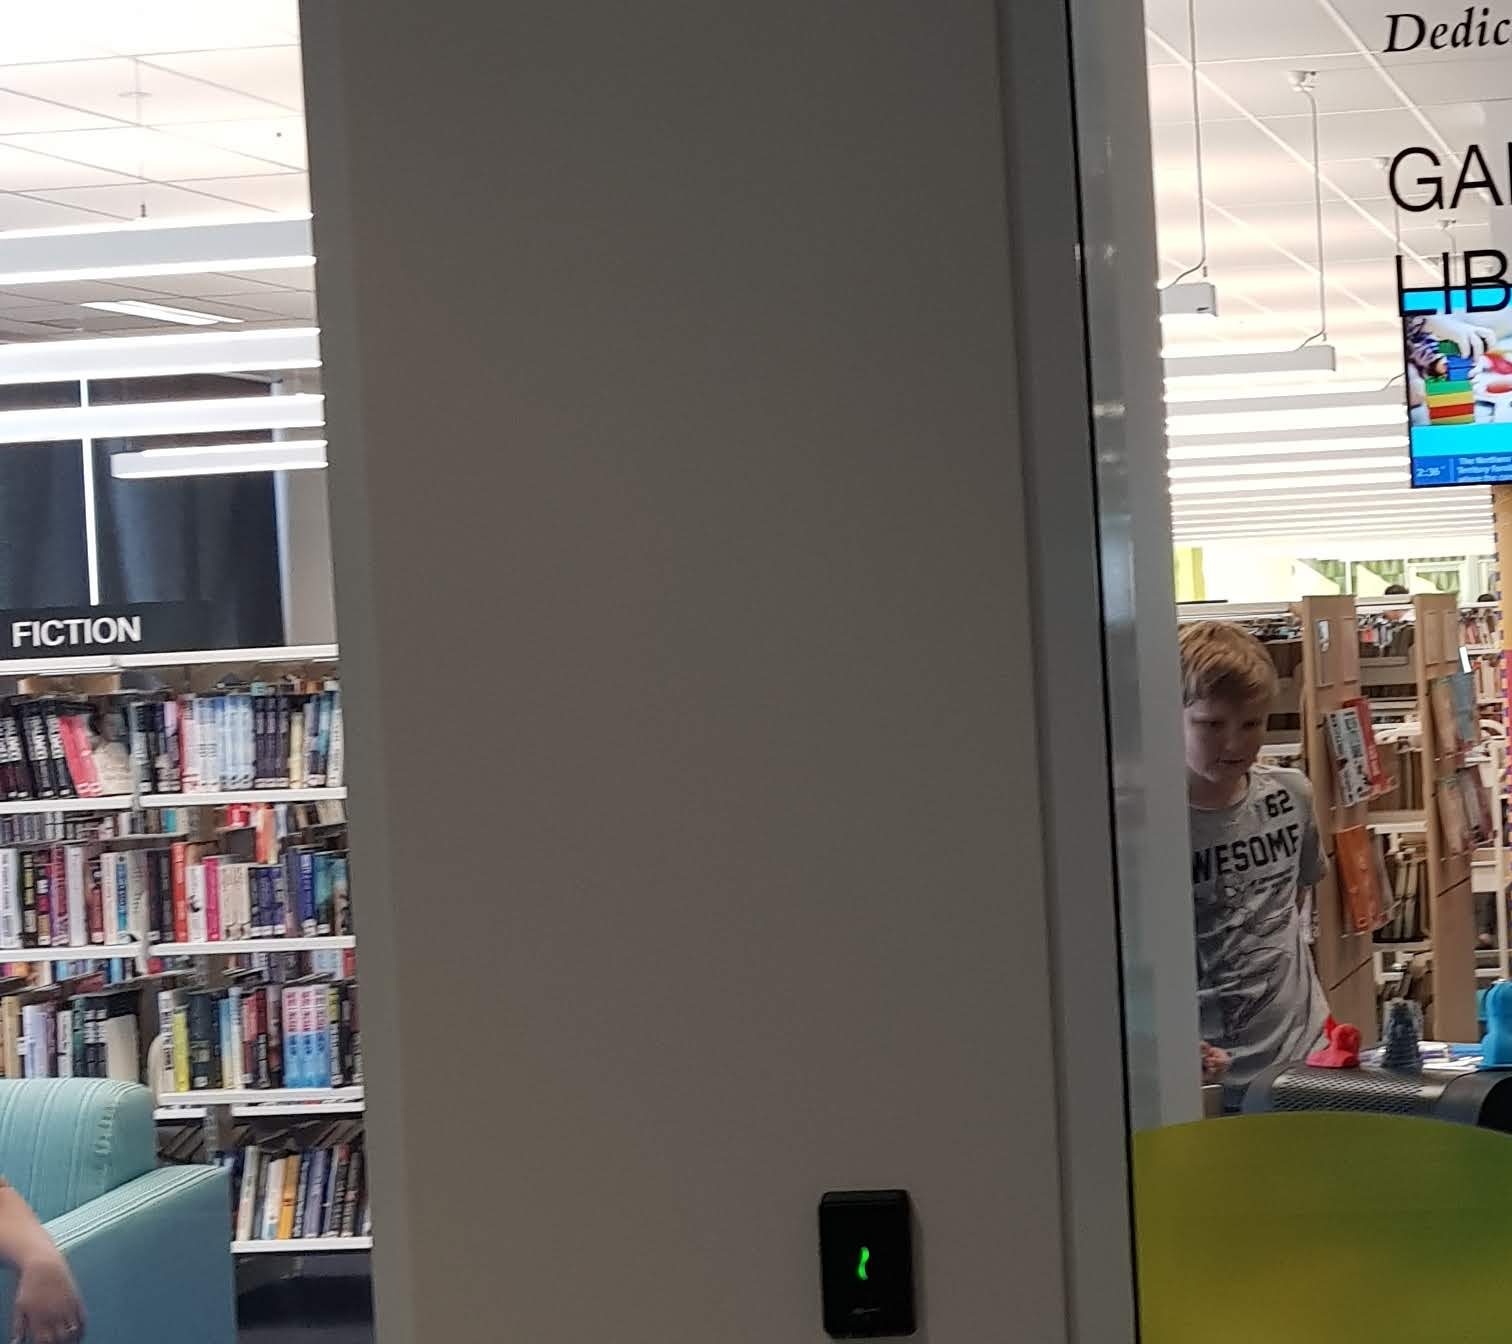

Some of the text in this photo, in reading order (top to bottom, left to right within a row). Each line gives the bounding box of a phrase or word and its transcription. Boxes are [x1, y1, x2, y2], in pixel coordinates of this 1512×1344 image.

[12, 616, 141, 647] FICTION
[1264, 788, 1295, 819] 62
[1193, 823, 1300, 884] WESOME
